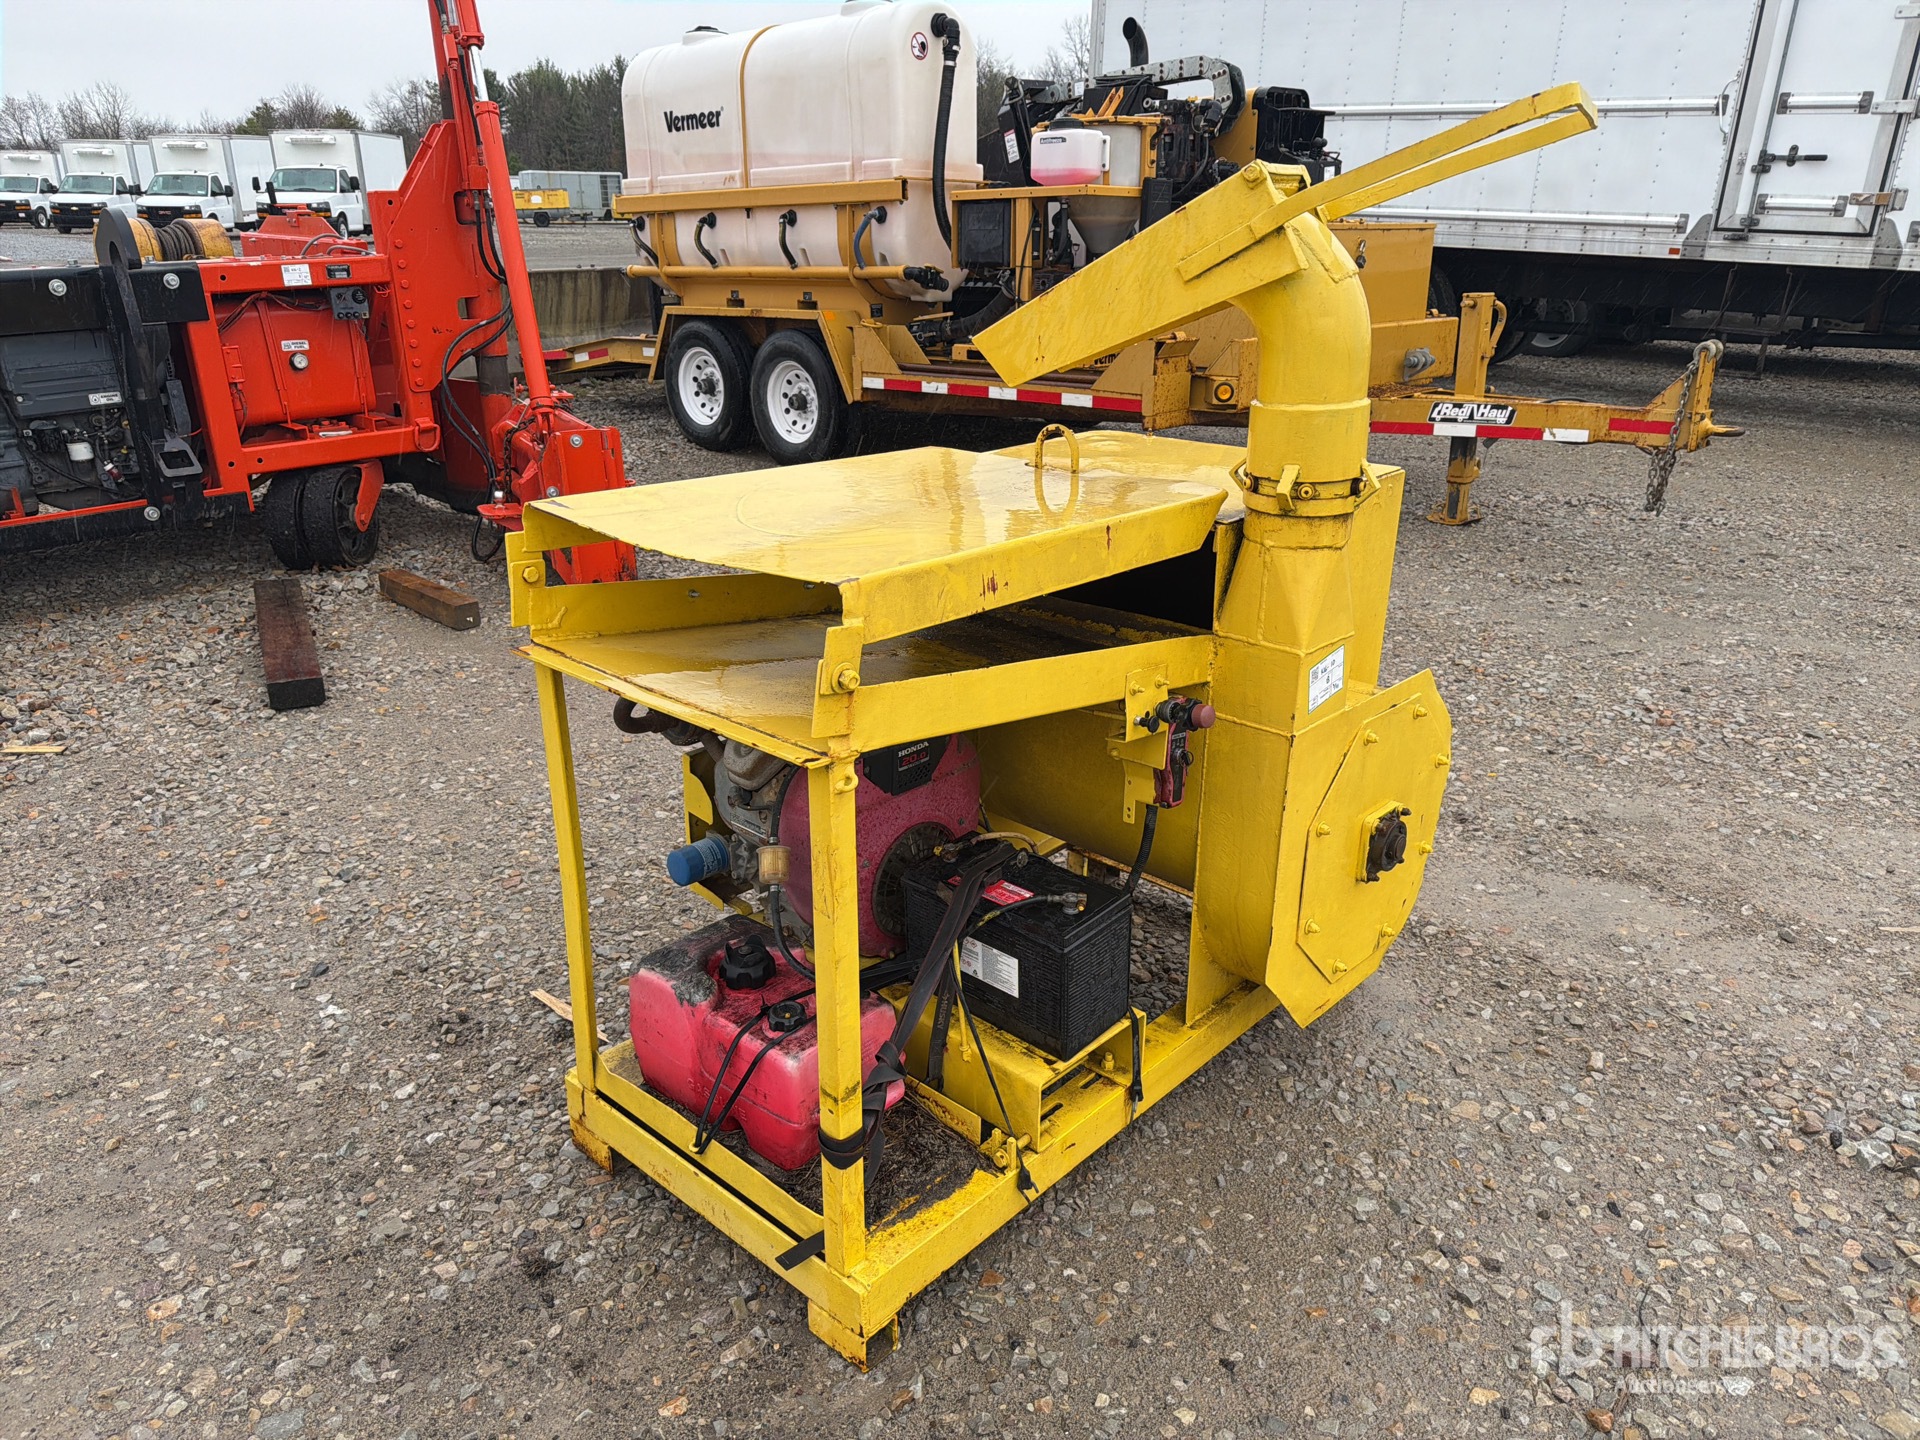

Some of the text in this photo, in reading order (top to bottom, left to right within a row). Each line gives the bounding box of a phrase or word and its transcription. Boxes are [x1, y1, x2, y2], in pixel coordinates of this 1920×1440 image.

[663, 109, 722, 133] Vermeer
[1094, 352, 1121, 365] Verm
[1477, 404, 1511, 418] Haul
[897, 741, 930, 758] HONDA
[902, 751, 927, 767] 20.0
[686, 1077, 748, 1121] GASLNE
